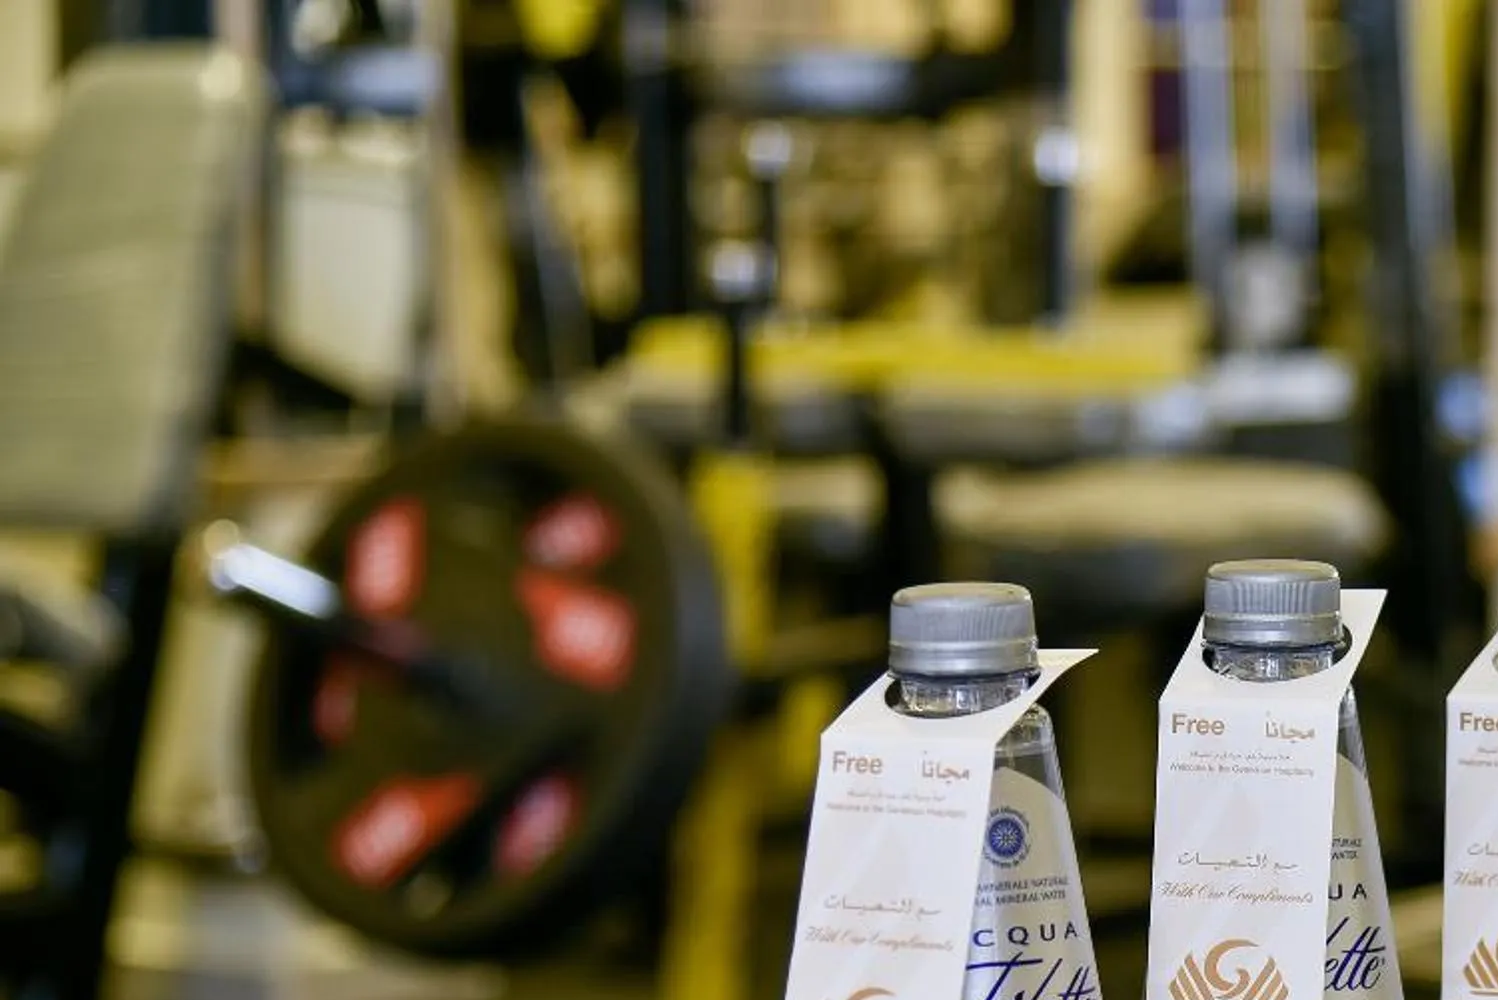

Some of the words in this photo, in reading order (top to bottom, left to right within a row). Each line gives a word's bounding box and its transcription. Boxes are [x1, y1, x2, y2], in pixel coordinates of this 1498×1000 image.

[1171, 713, 1225, 736] Free
[832, 751, 883, 774] Free
[1158, 881, 1198, 899] With
[973, 920, 1079, 947] CQUA
